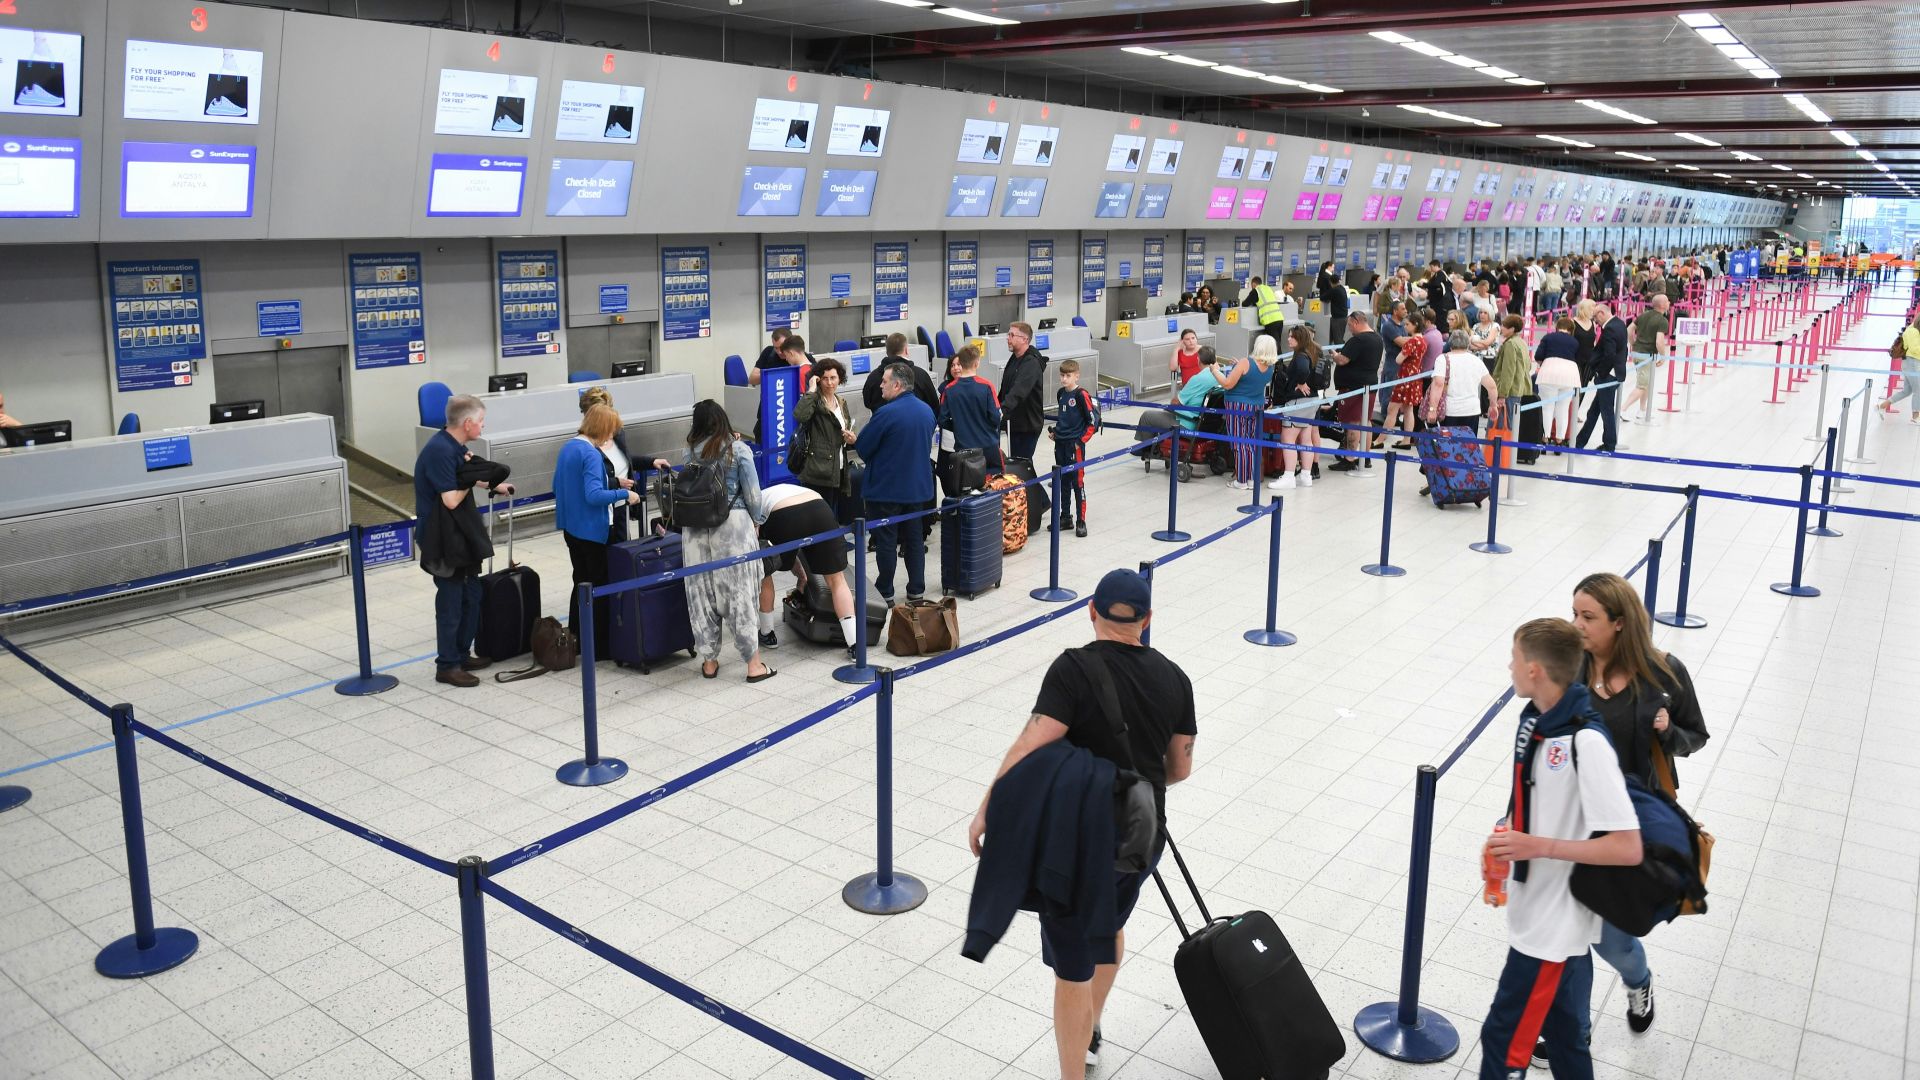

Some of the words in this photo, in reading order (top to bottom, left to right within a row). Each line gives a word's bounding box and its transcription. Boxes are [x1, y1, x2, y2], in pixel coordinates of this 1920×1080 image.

[190, 8, 208, 32] 3
[487, 41, 500, 61] 4
[602, 54, 615, 73] 5
[26, 144, 74, 153] SunExpress
[565, 177, 597, 187] Check-in
[599, 179, 616, 188] Desk
[754, 182, 778, 191] Check-in
[830, 184, 852, 192] Check-in
[578, 189, 602, 198] Closed
[762, 192, 781, 201] Closed
[838, 194, 855, 202] Closed
[371, 531, 396, 540] NOTICE
